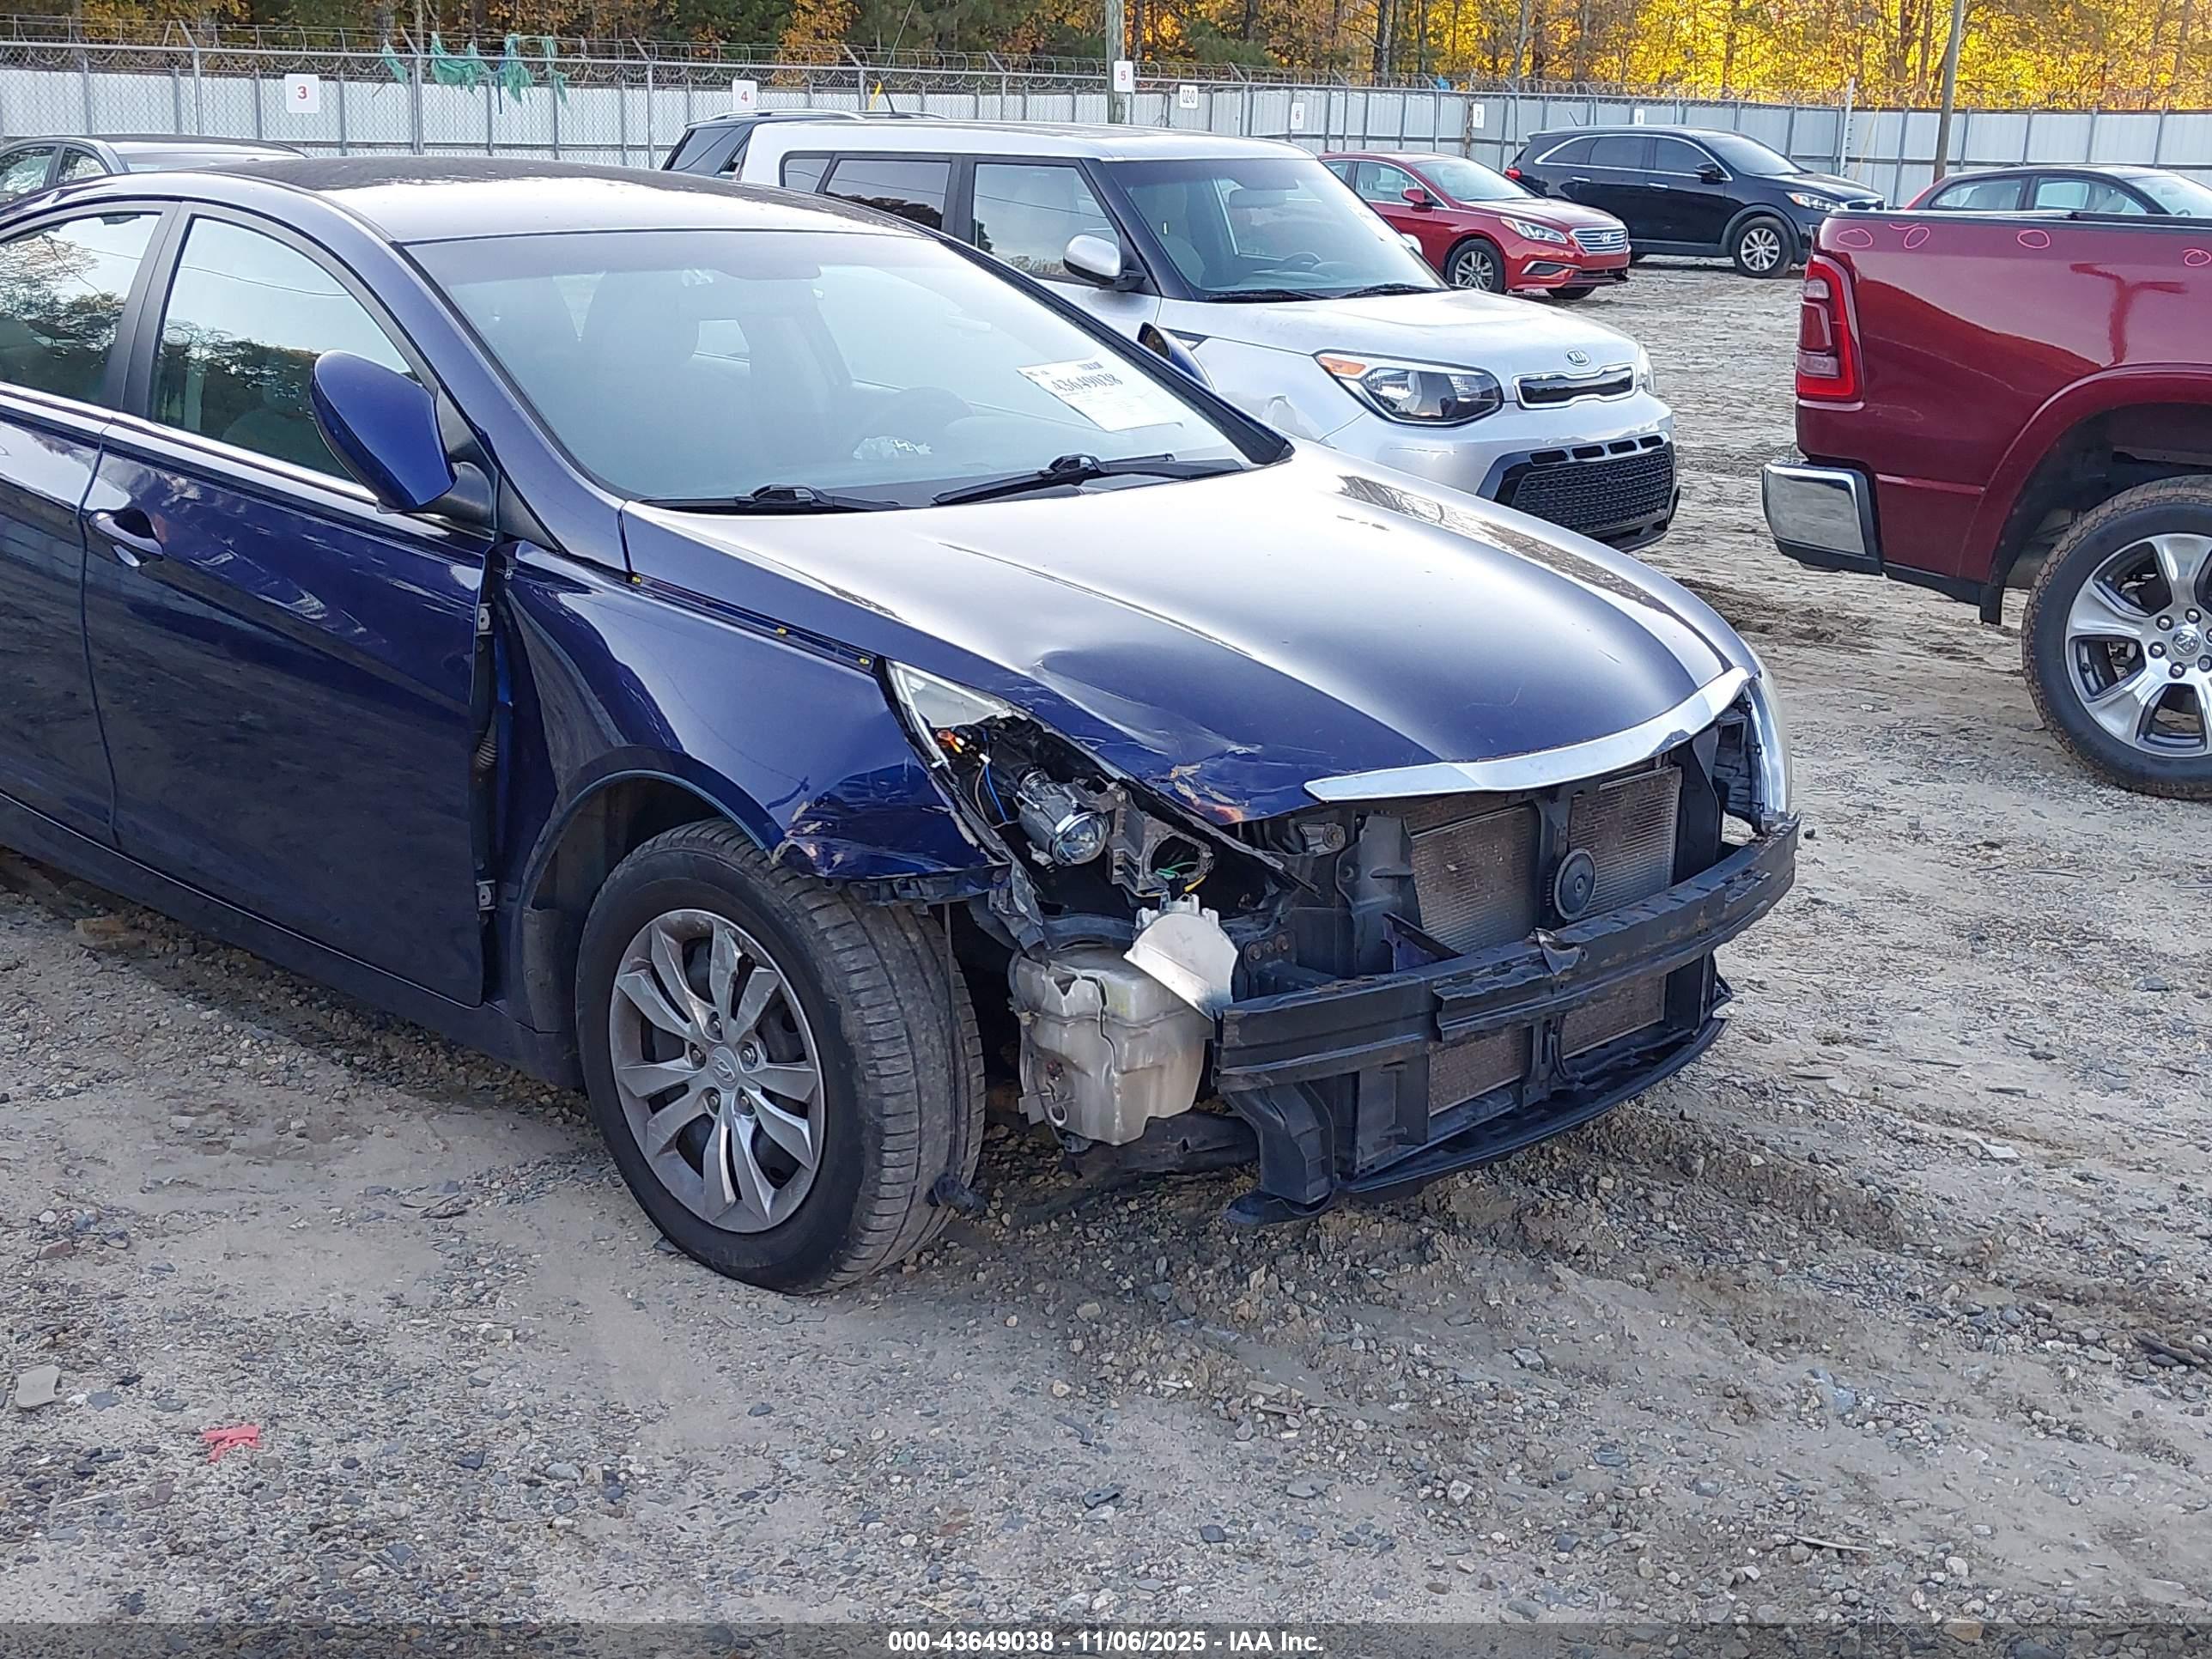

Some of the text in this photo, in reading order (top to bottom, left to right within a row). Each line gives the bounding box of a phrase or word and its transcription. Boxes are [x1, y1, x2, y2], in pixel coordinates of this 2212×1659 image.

[1120, 70, 1127, 81] 5
[297, 85, 308, 99] 3
[740, 90, 749, 102] 4
[1567, 350, 1588, 362] KIA
[1050, 373, 1124, 392] 43649038
